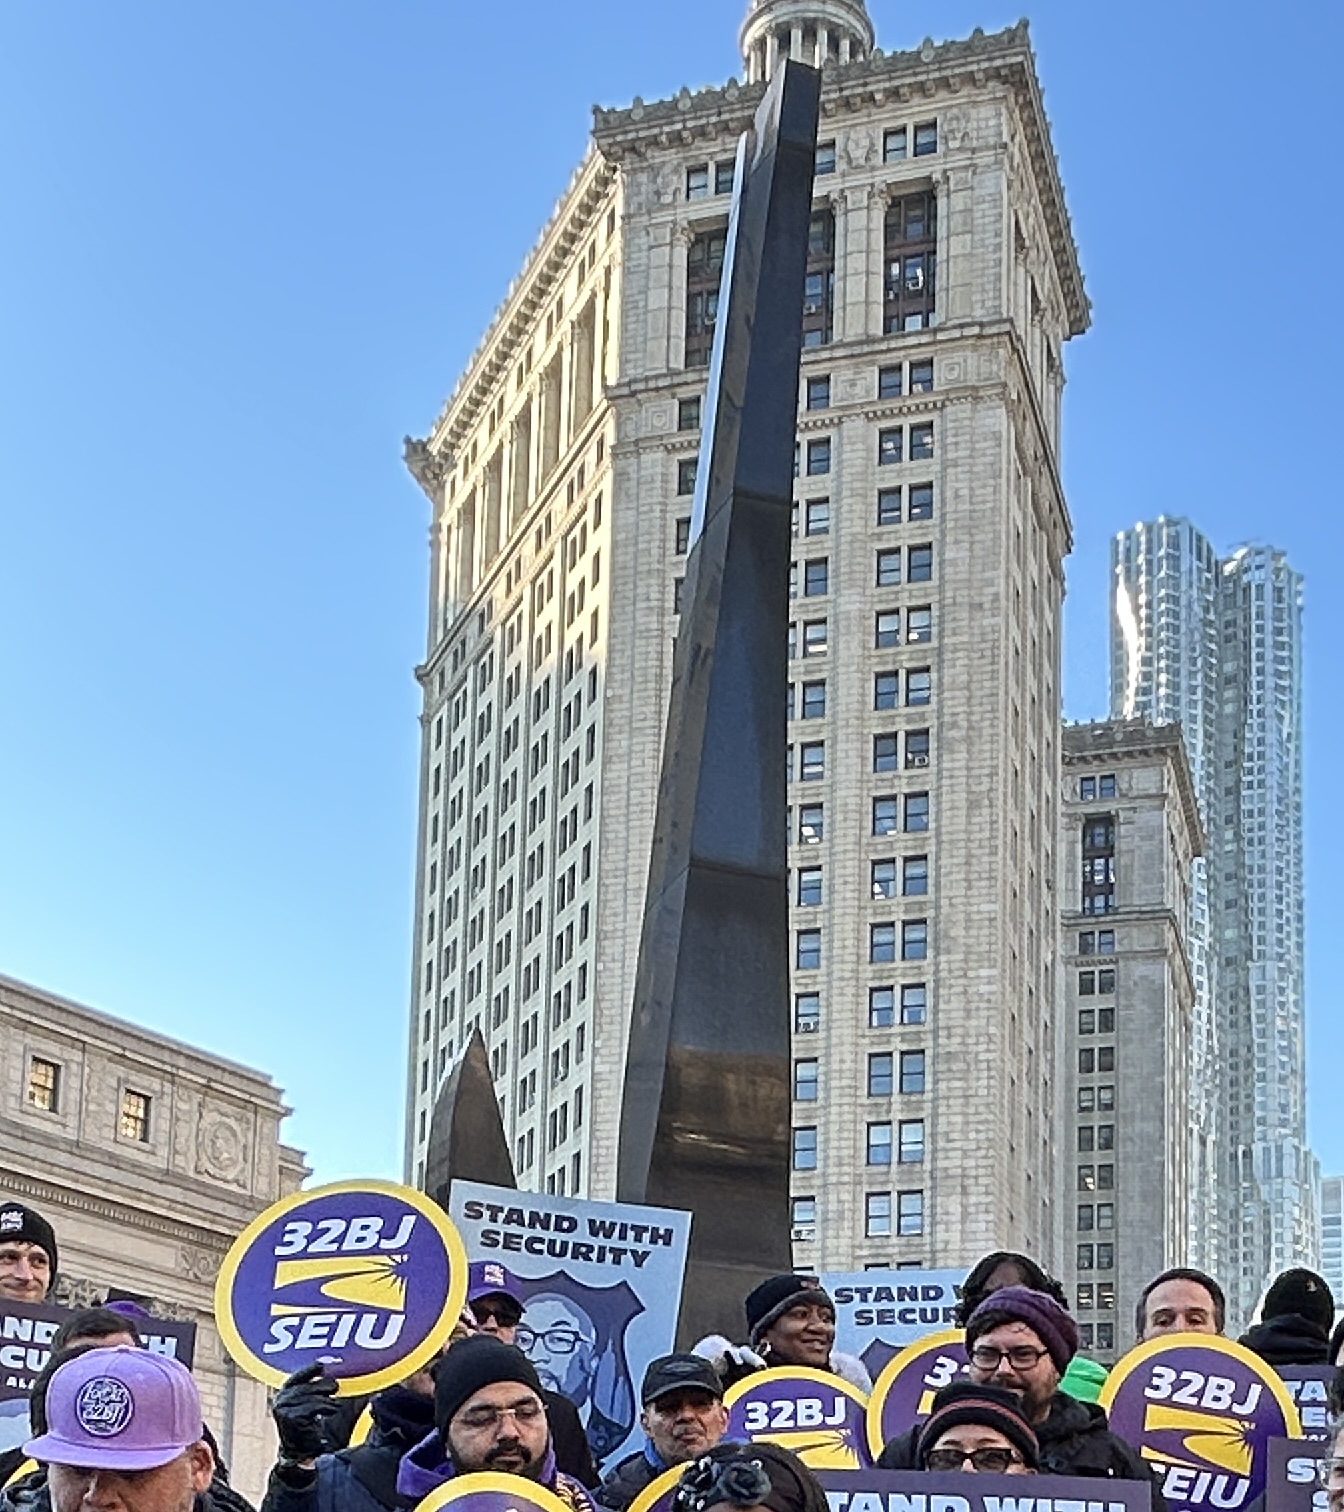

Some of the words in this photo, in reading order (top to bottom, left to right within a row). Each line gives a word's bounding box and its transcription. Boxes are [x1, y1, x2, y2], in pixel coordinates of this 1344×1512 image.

[274, 1214, 417, 1257] 32BJ
[463, 1200, 578, 1235] STAND
[588, 1217, 674, 1247] WITH
[479, 1228, 652, 1270] SECURITY
[834, 1284, 945, 1304] STAND
[263, 1314, 406, 1354] SEIU
[854, 1306, 958, 1326] SECUR
[1144, 1365, 1262, 1416] 32BJ
[744, 1396, 846, 1431] 32BJ
[1150, 1462, 1250, 1509] EIU
